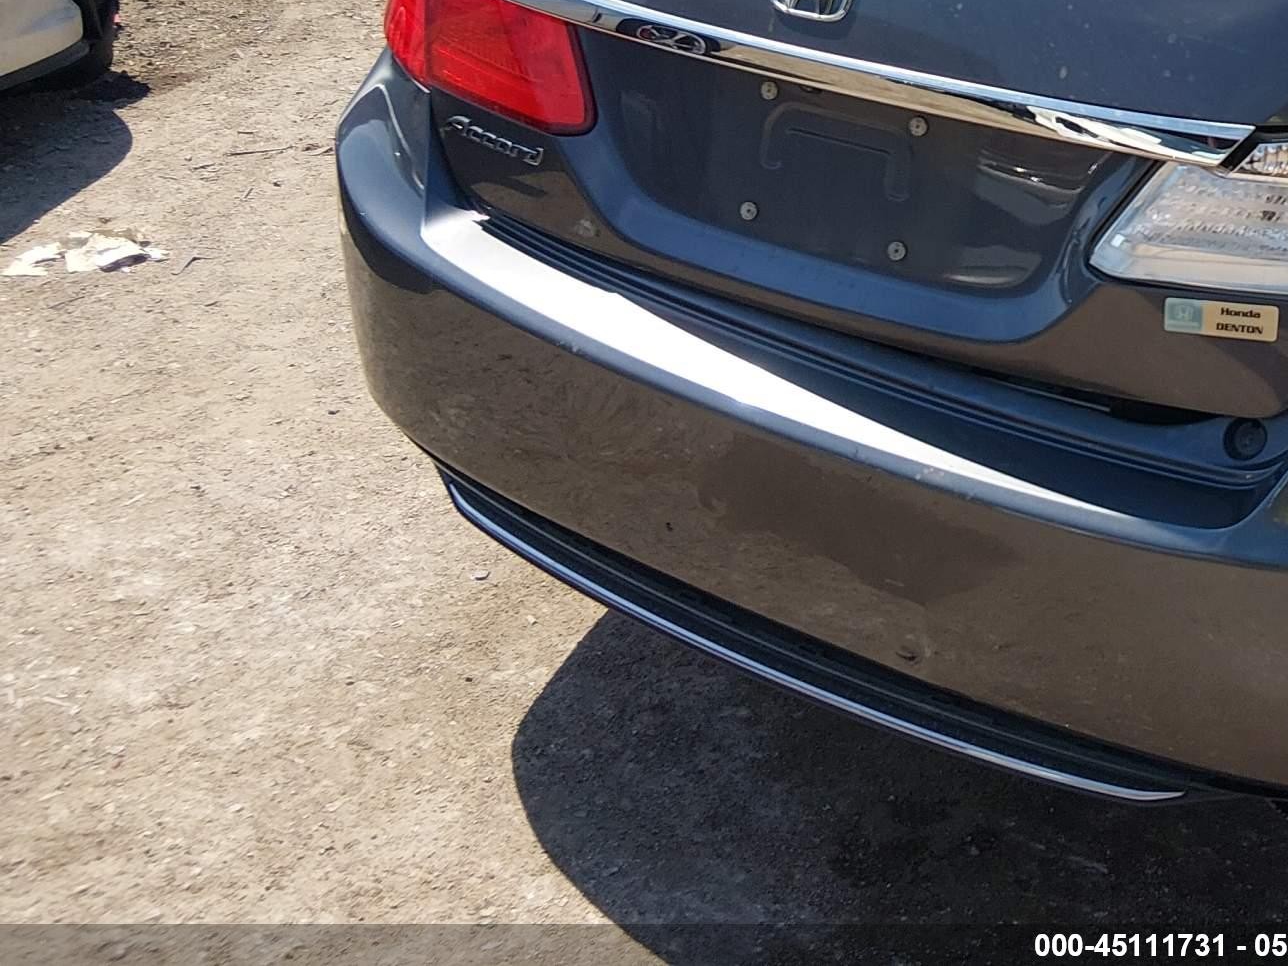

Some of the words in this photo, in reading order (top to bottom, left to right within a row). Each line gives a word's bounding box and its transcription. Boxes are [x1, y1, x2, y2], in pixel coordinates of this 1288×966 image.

[441, 115, 544, 166] Accord
[1220, 307, 1262, 319] Honda
[1215, 322, 1264, 335] DENTON
